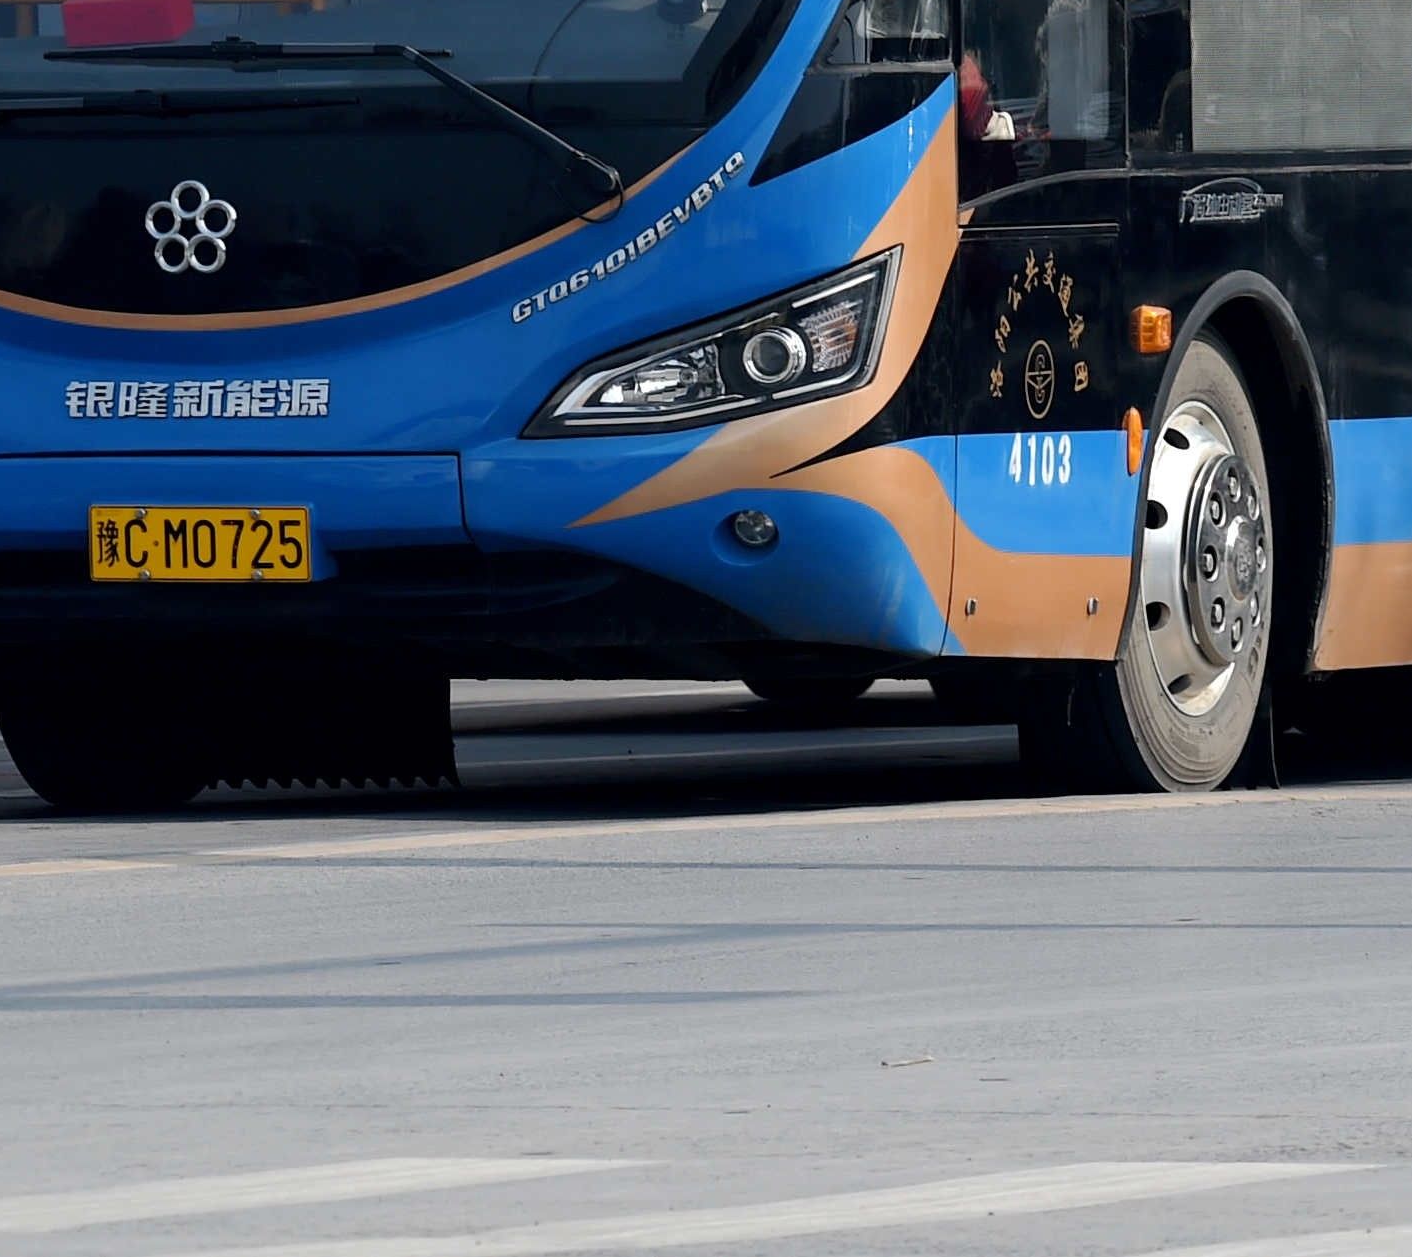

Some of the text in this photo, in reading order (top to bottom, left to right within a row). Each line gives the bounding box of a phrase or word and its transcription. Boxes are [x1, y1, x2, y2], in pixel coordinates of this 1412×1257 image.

[64, 378, 331, 419] 银隆新能源
[1008, 432, 1072, 487] 4103
